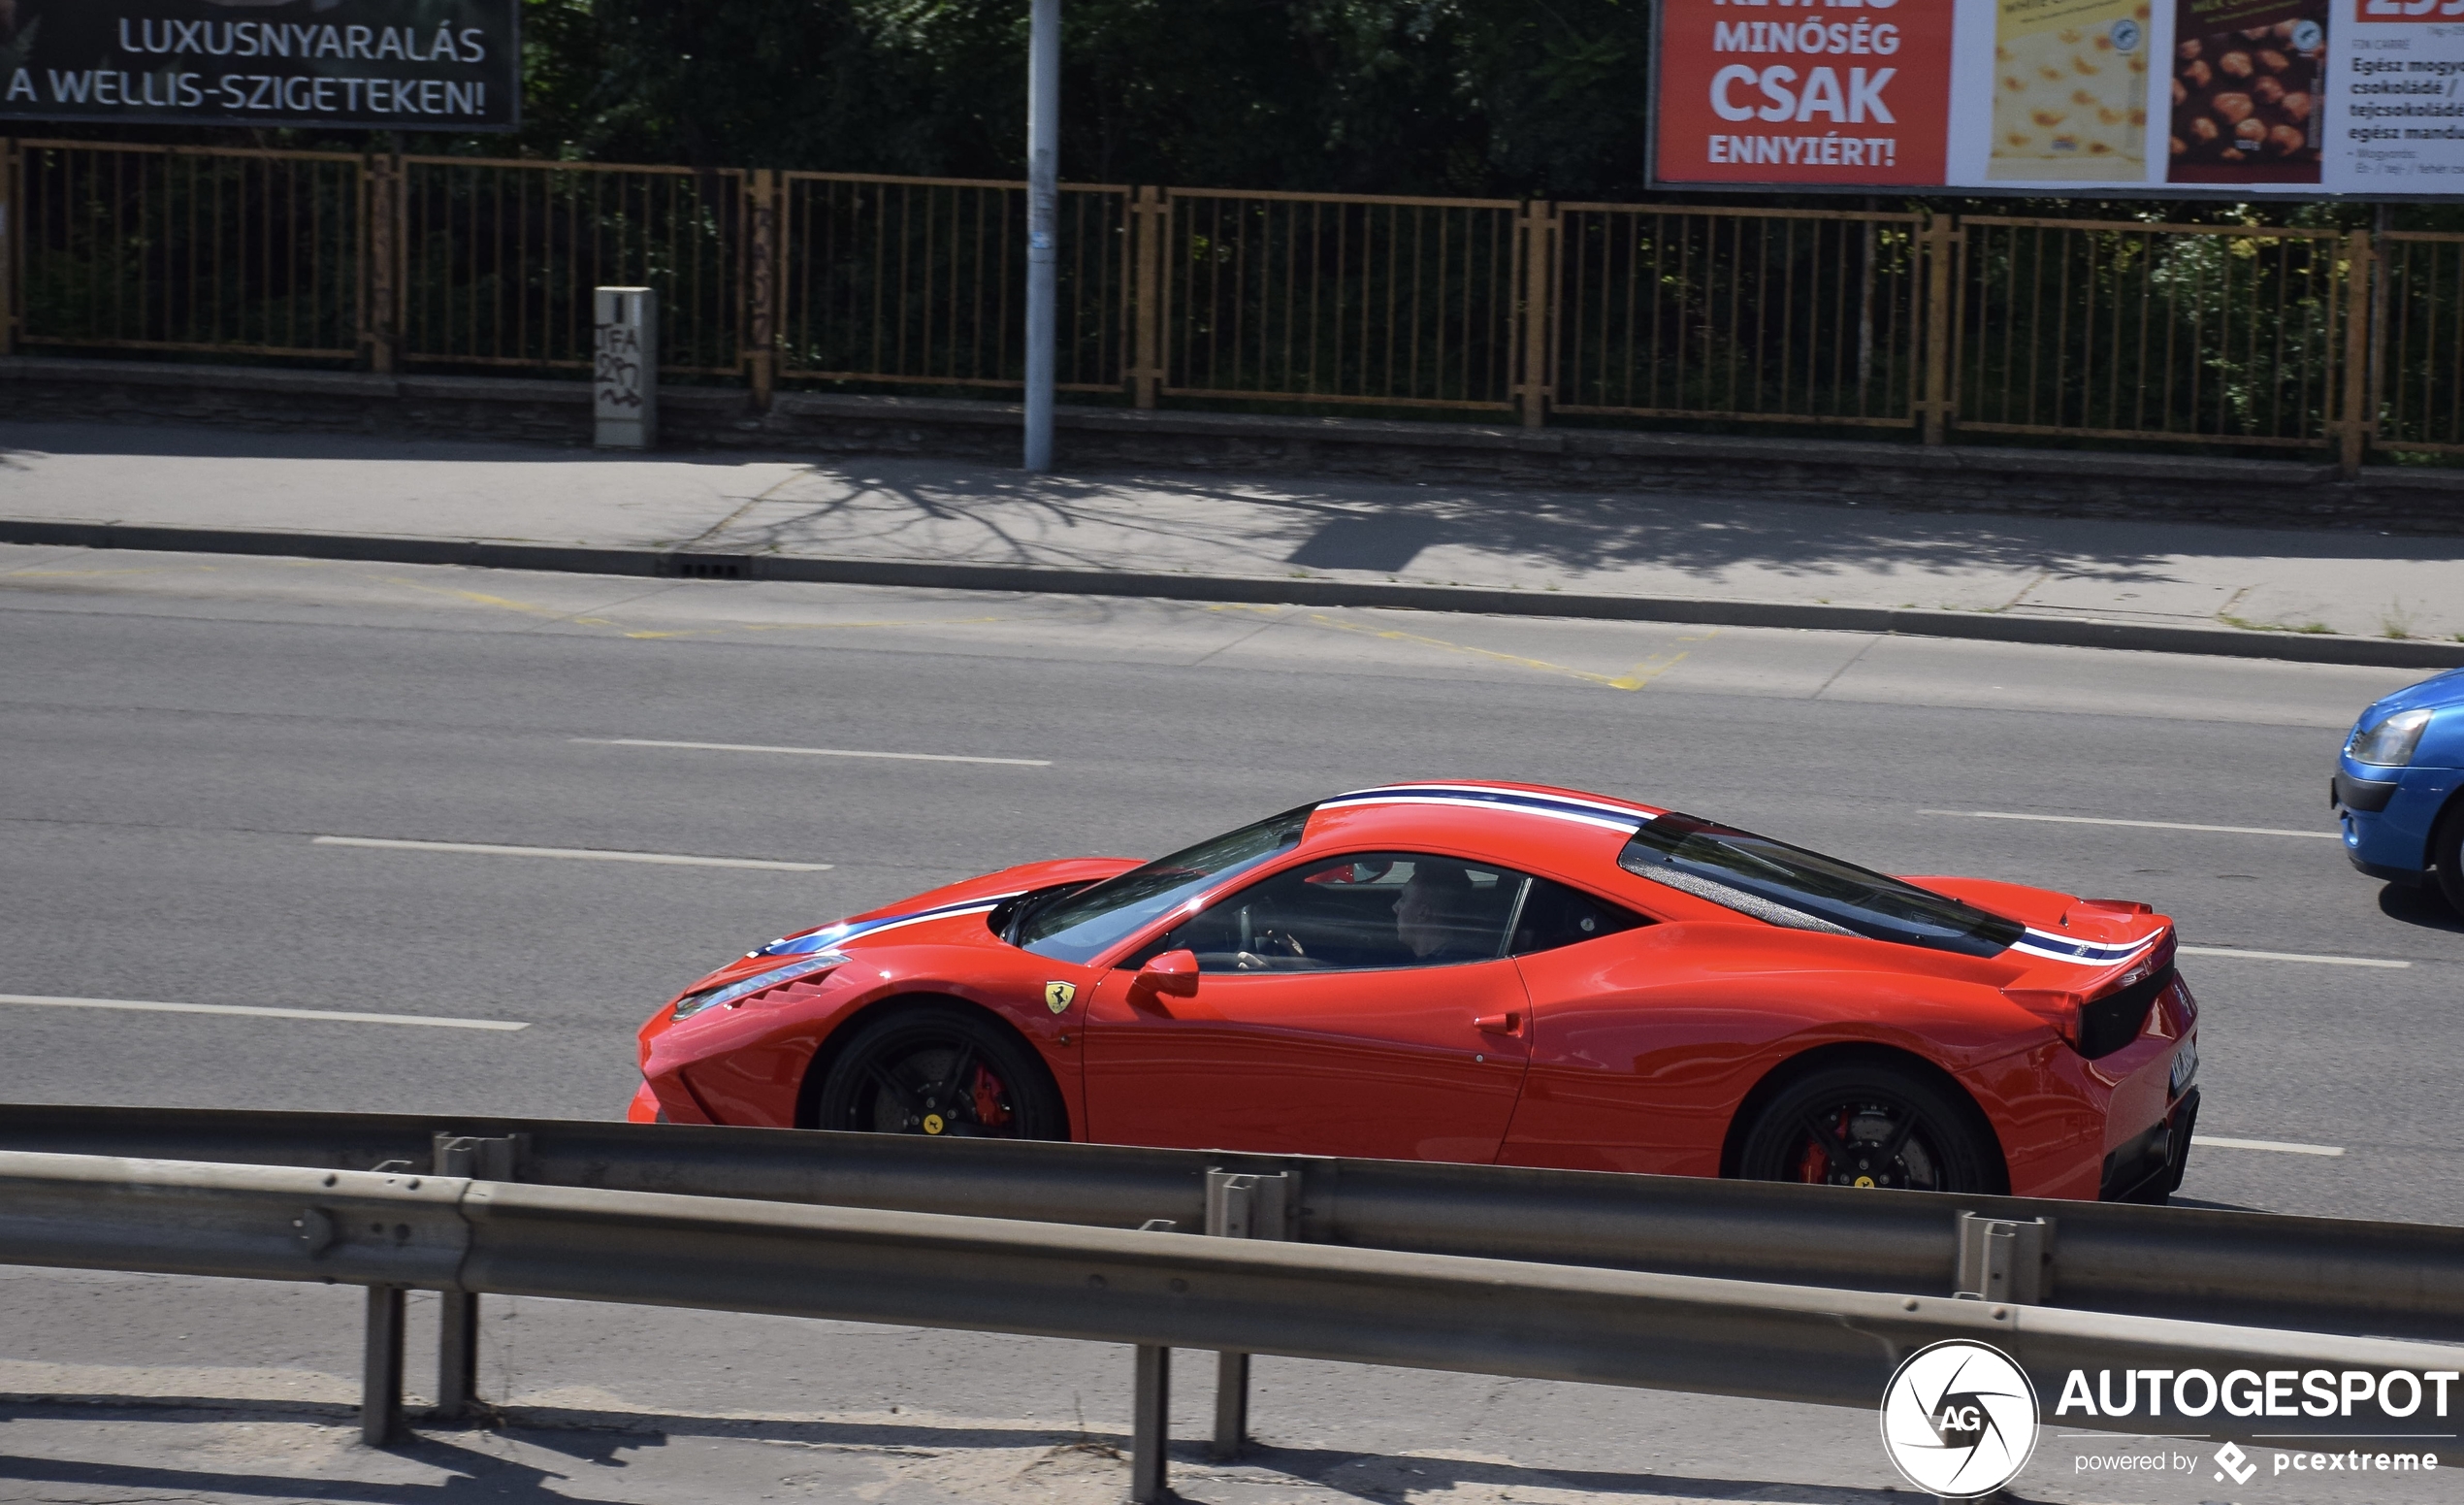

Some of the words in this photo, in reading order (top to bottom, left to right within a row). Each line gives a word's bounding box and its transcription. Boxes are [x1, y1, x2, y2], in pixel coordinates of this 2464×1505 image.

[118, 17, 485, 63] LUXUSNYARALÁS
[1713, 16, 1901, 54] MINŐSÉG
[2351, 57, 2403, 76] Egész
[8, 68, 37, 102] A
[48, 69, 485, 115] WELLIS-SZIGETEKEN!
[1709, 64, 1898, 124] CSAK
[2351, 80, 2443, 95] csokoládé
[1708, 131, 1897, 167] ENNYIÉRT!
[2349, 124, 2400, 143] egész
